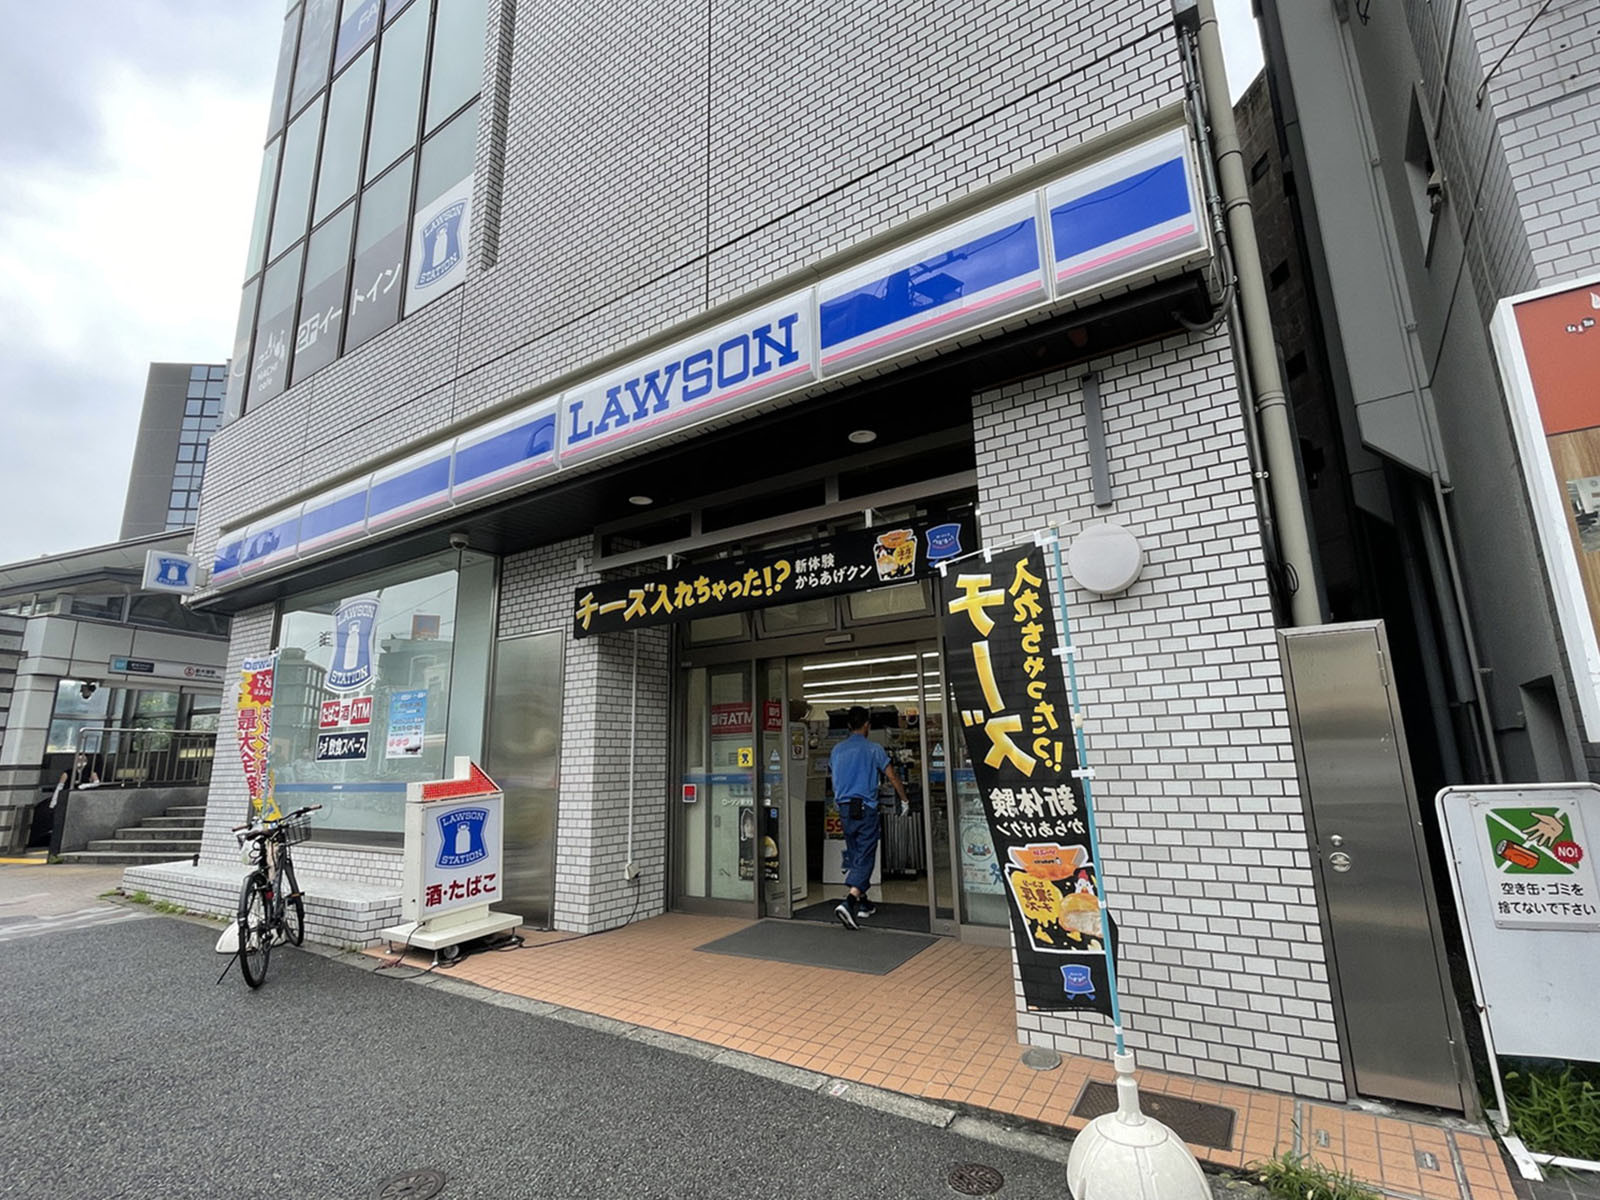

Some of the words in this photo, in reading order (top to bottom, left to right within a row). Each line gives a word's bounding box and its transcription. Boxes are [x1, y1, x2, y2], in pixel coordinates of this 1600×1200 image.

[567, 312, 799, 445] LAWSON
[795, 553, 835, 574] 新体験
[795, 564, 872, 590] からあげクン
[338, 605, 375, 626] LAWSON
[331, 665, 368, 684] STATION
[320, 705, 340, 722] たばこ
[341, 704, 351, 721] 酒
[351, 702, 370, 720] ATM
[328, 737, 366, 756] 飲食スペース
[442, 811, 484, 826] LAWSON
[441, 849, 483, 864] STATION
[1557, 847, 1578, 858] NO!
[425, 873, 496, 907] 酒・たばこ
[1501, 883, 1584, 896] 空き缶・ゴミを
[1498, 901, 1596, 916] 捨てないで下さい
